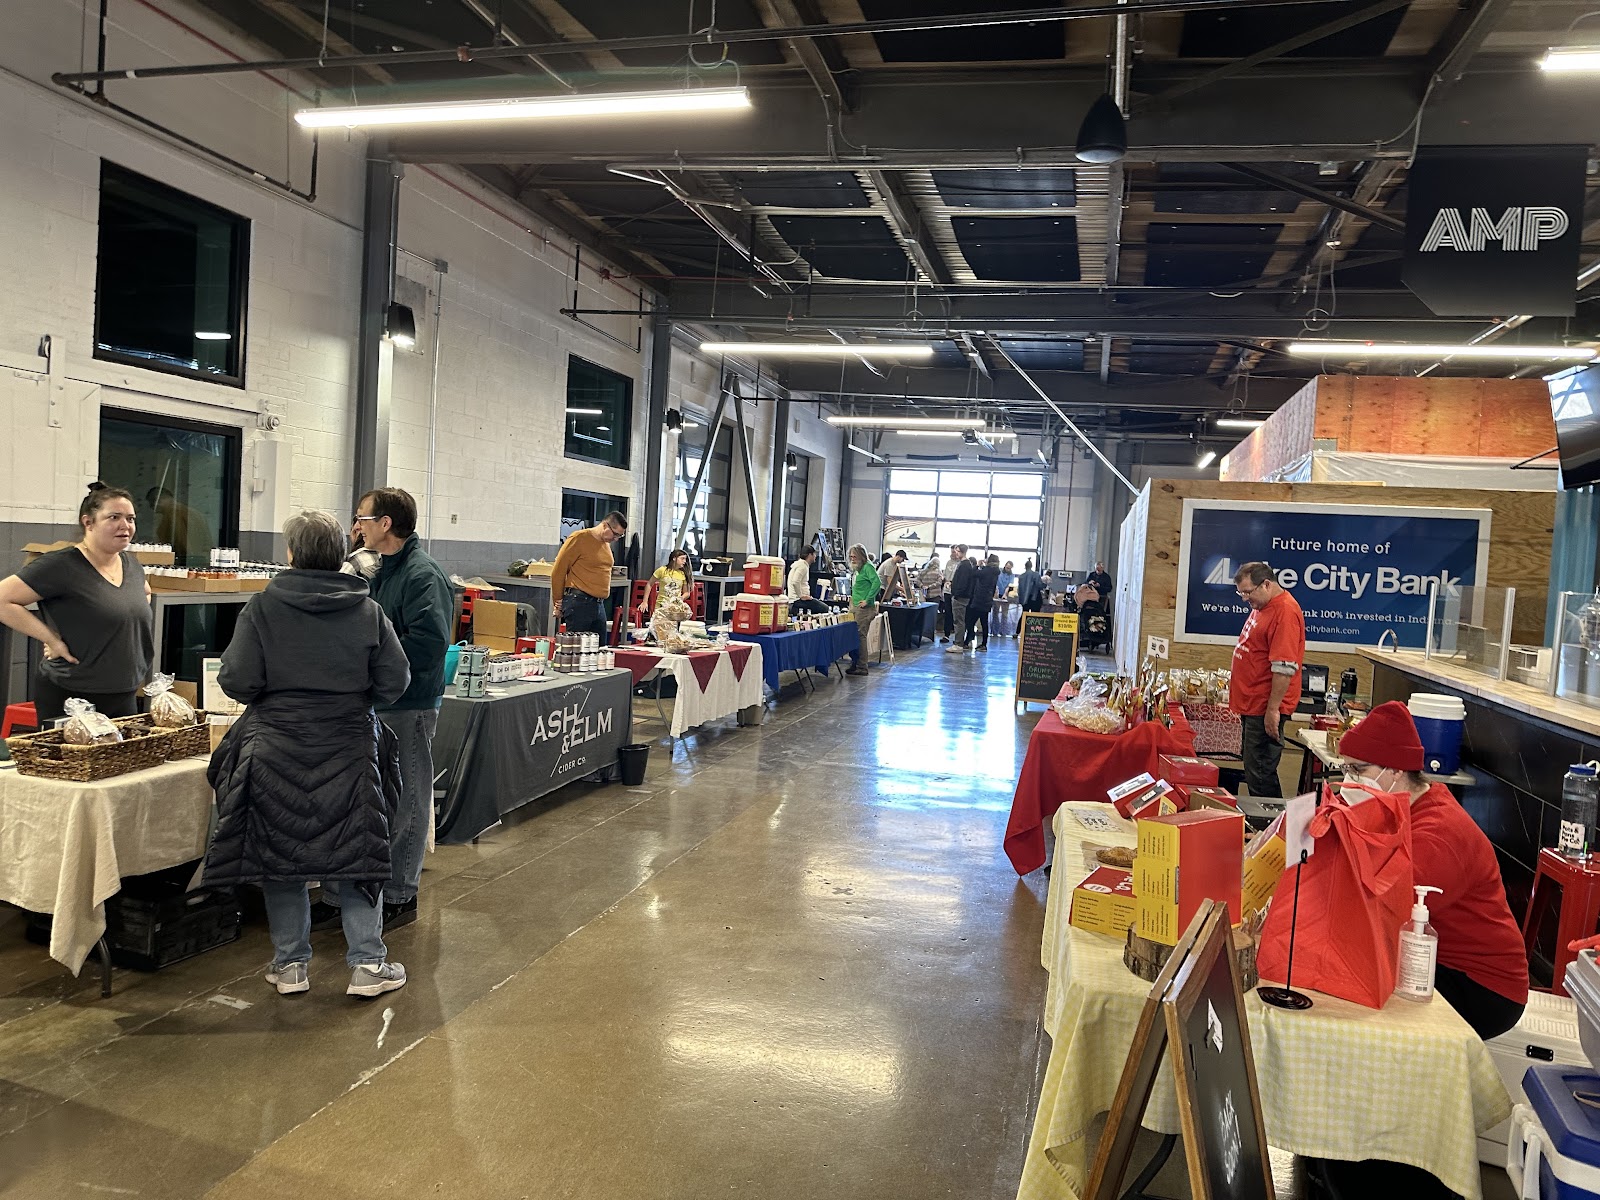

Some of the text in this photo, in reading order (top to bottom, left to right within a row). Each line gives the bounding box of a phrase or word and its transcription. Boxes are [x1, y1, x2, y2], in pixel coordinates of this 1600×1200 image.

[1419, 206, 1570, 252] AMP
[1272, 537, 1391, 554] Future home of
[1204, 557, 1461, 599] Le City Bank
[1202, 603, 1230, 613] We're
[1232, 605, 1249, 614] the
[1320, 611, 1344, 619] 100%
[1346, 612, 1392, 623] invested
[1395, 614, 1406, 623] in
[530, 703, 579, 746] ASH
[569, 707, 613, 748] ELM
[561, 734, 571, 755] &
[558, 760, 576, 775] CIDER
